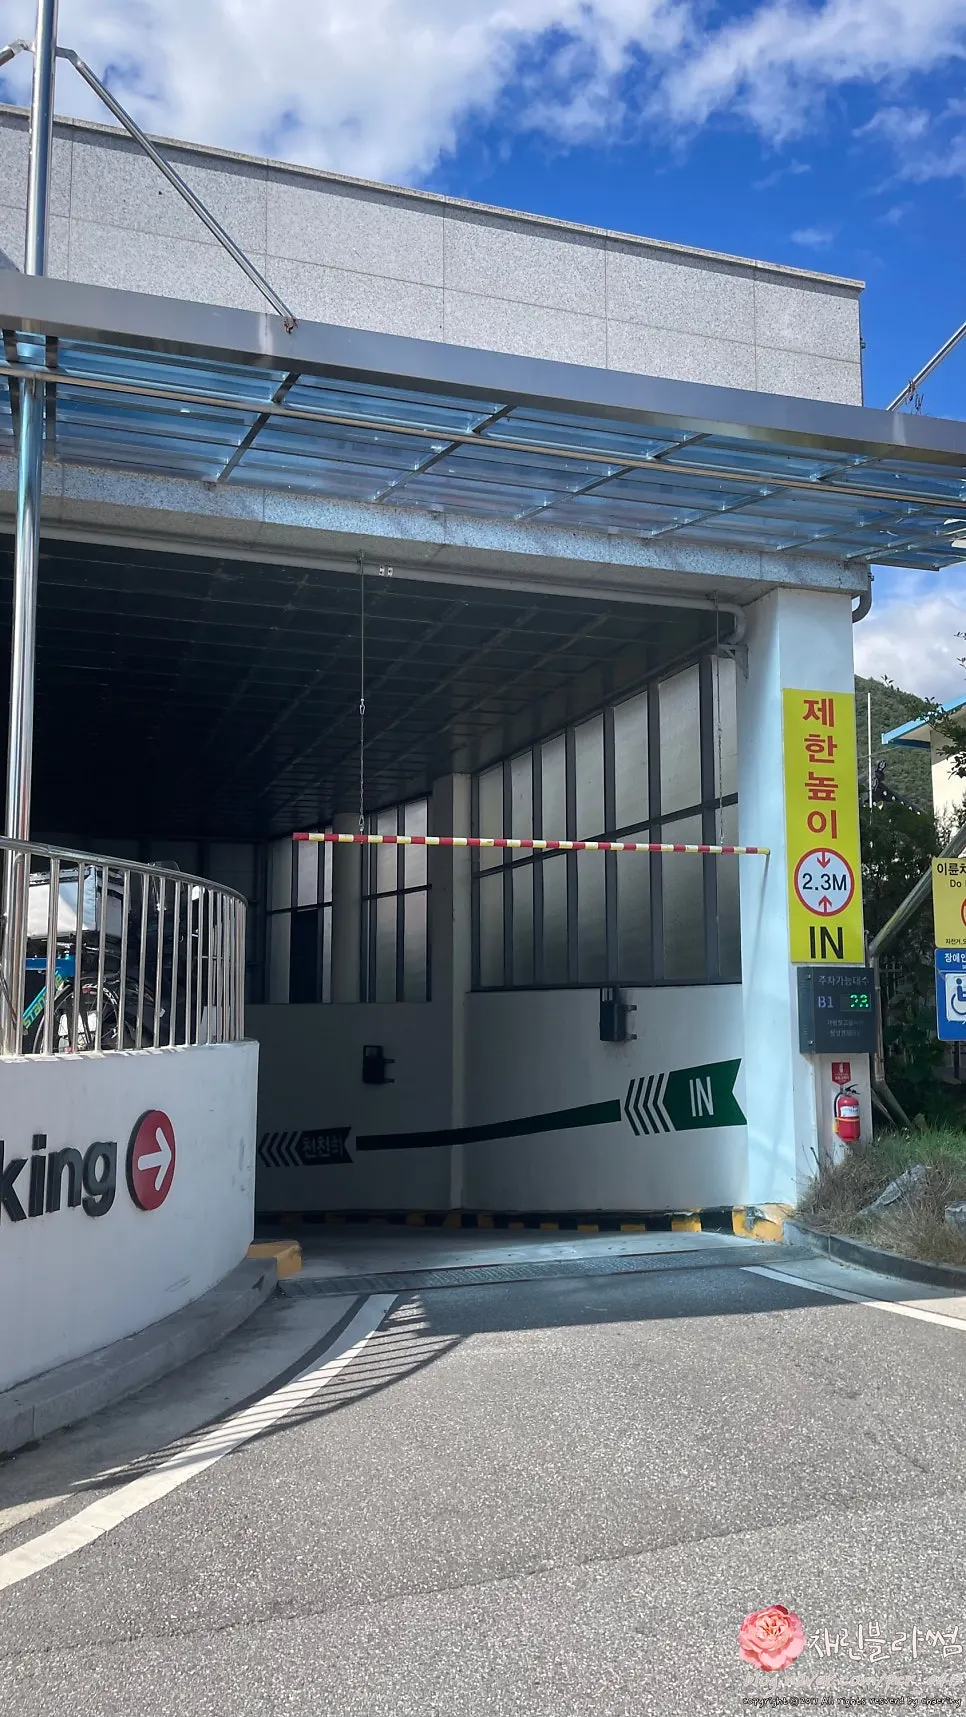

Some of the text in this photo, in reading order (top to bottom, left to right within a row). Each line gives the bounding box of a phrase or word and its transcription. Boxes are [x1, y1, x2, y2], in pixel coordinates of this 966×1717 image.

[802, 698, 838, 839] 제한높이
[802, 873, 847, 891] 2.3M
[949, 879, 961, 888] Do
[809, 926, 844, 959] IN
[817, 995, 834, 1009] B1
[689, 1076, 714, 1117] IN
[302, 1134, 343, 1159] 천천히
